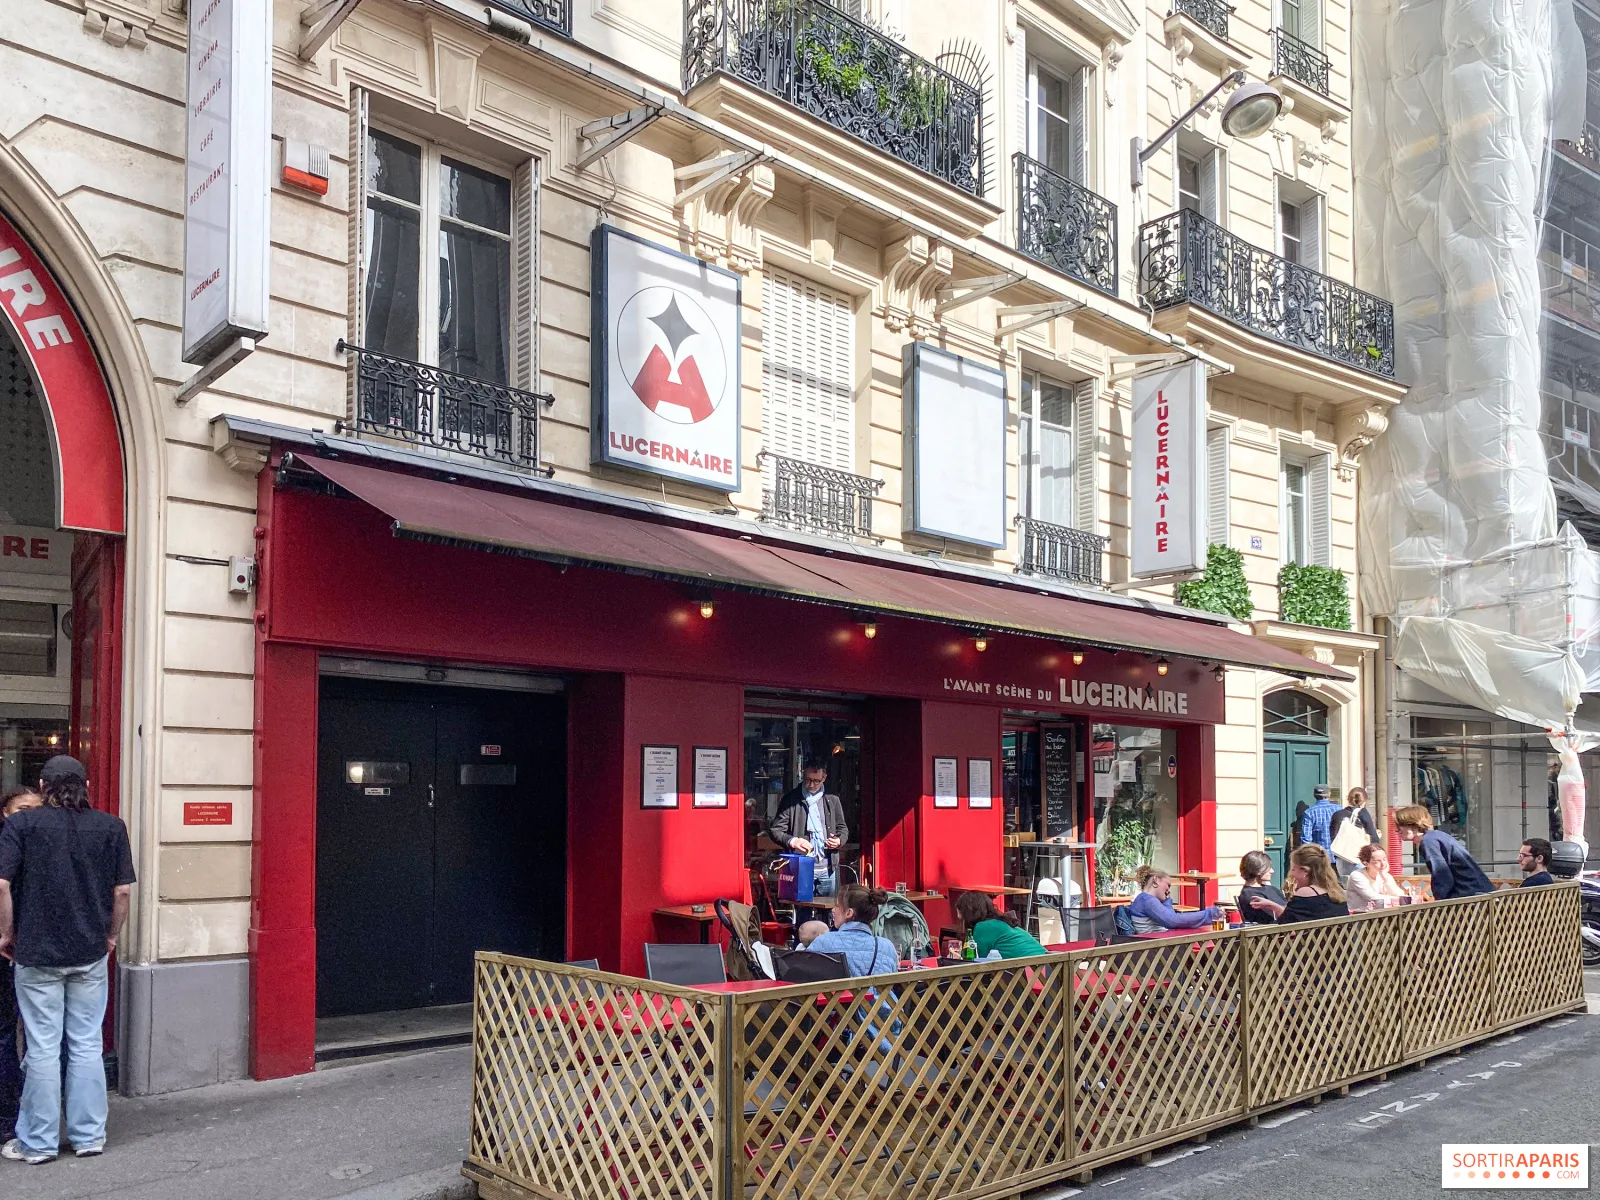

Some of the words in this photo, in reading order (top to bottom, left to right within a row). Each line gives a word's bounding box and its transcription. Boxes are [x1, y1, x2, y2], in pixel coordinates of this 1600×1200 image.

[198, 40, 218, 70] CINÉMA
[194, 78, 221, 117] LIBRAIRIE
[200, 128, 214, 152] CAFÉ
[190, 161, 224, 206] RESTAURANT
[190, 268, 220, 301] LUCERNAIRE
[610, 431, 733, 475] LUCERNAIRE
[1155, 390, 1170, 553] LUCERNAIRE
[2, 535, 50, 560] RE
[943, 677, 991, 694] L'AVANT
[995, 682, 1032, 699] SCÈNE
[1037, 689, 1052, 701] DU
[1059, 678, 1188, 715] LUCERNAIRE
